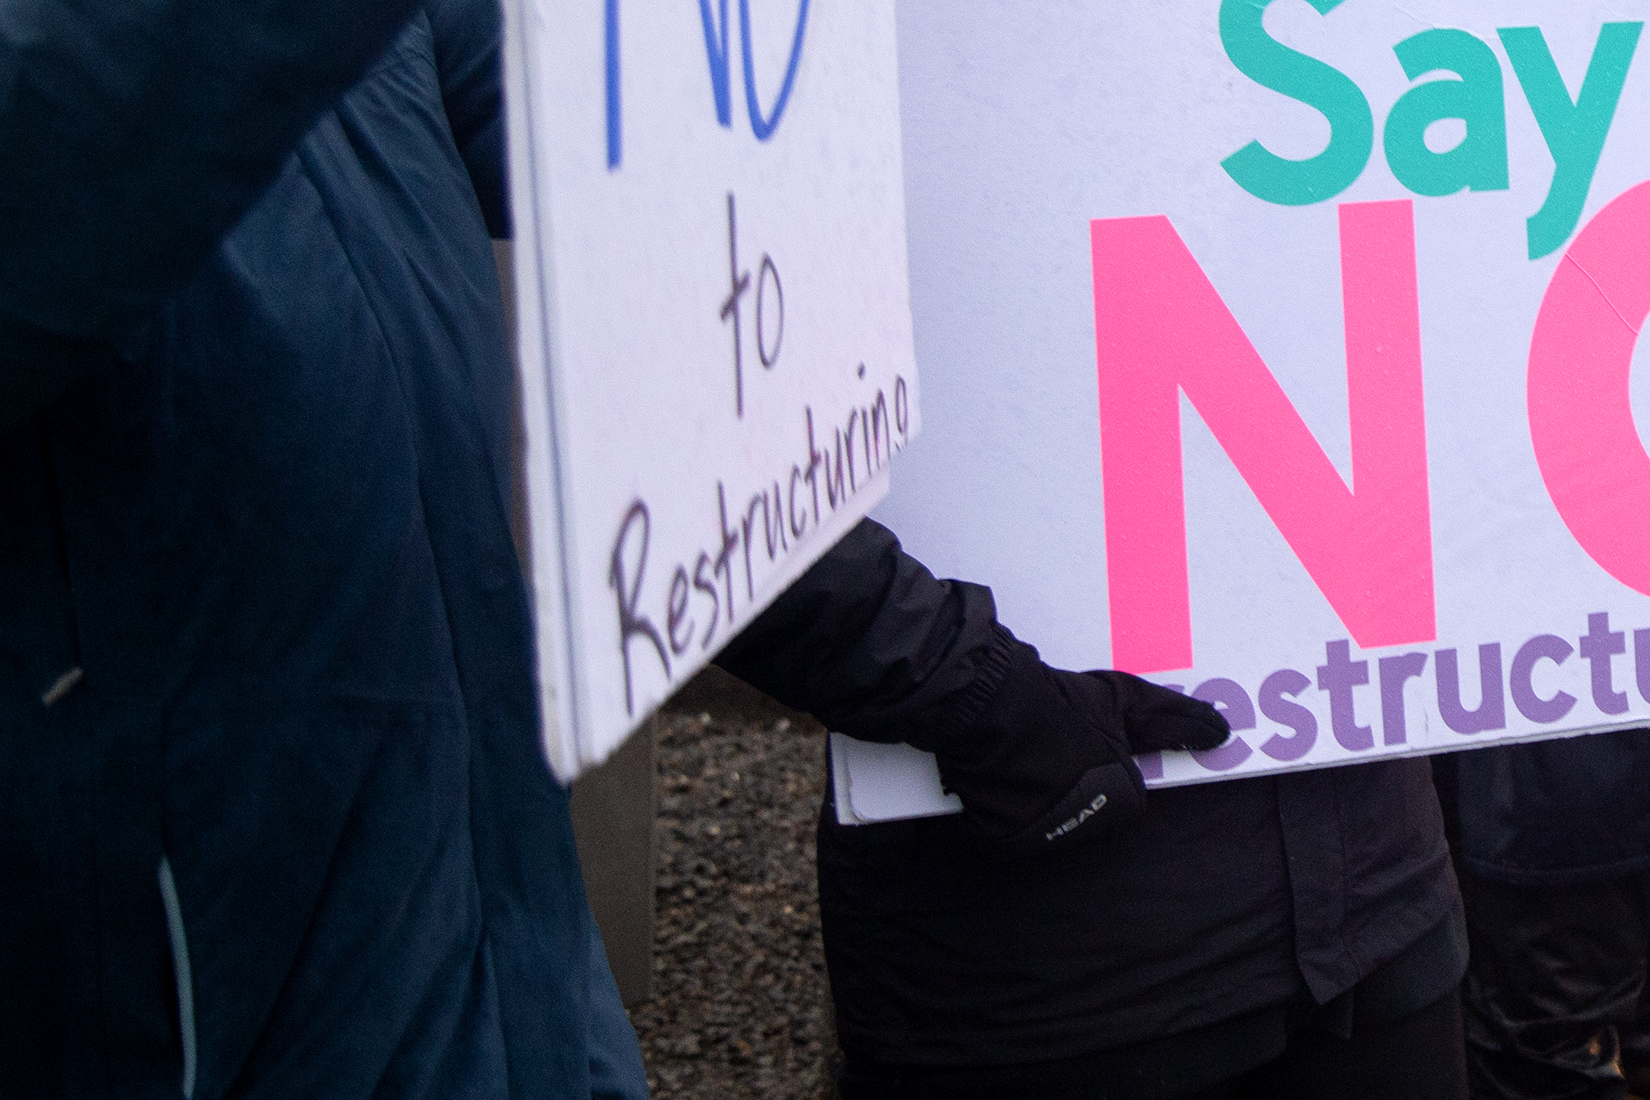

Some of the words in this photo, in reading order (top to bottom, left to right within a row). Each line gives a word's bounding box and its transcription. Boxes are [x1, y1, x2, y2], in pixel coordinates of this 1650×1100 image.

[719, 190, 785, 421] to
[607, 360, 909, 718] Restructuring
[1045, 793, 1108, 841] HEAD
